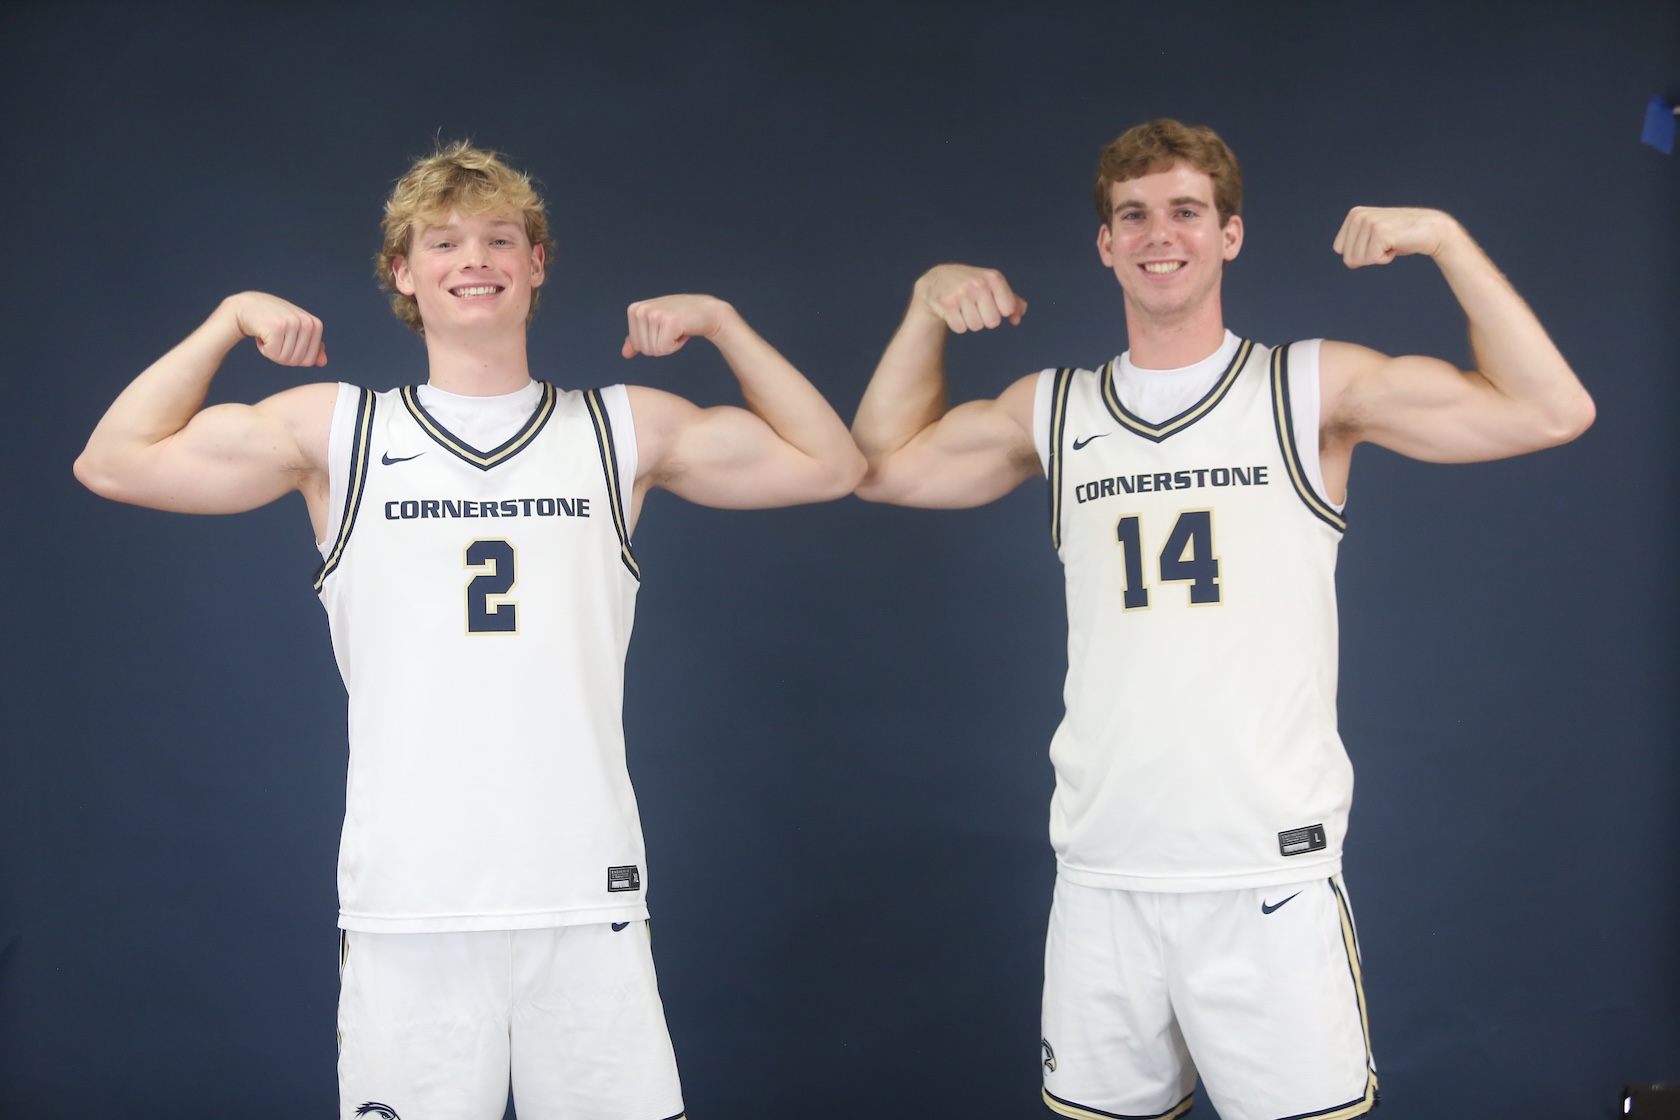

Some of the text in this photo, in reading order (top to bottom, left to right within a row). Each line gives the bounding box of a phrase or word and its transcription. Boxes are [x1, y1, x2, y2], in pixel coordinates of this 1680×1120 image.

[1075, 466, 1269, 504] CORNERSTONE
[385, 498, 590, 520] CORNERSTONE
[1114, 506, 1224, 613] 14
[463, 536, 520, 636] 2
[1314, 832, 1321, 842] L
